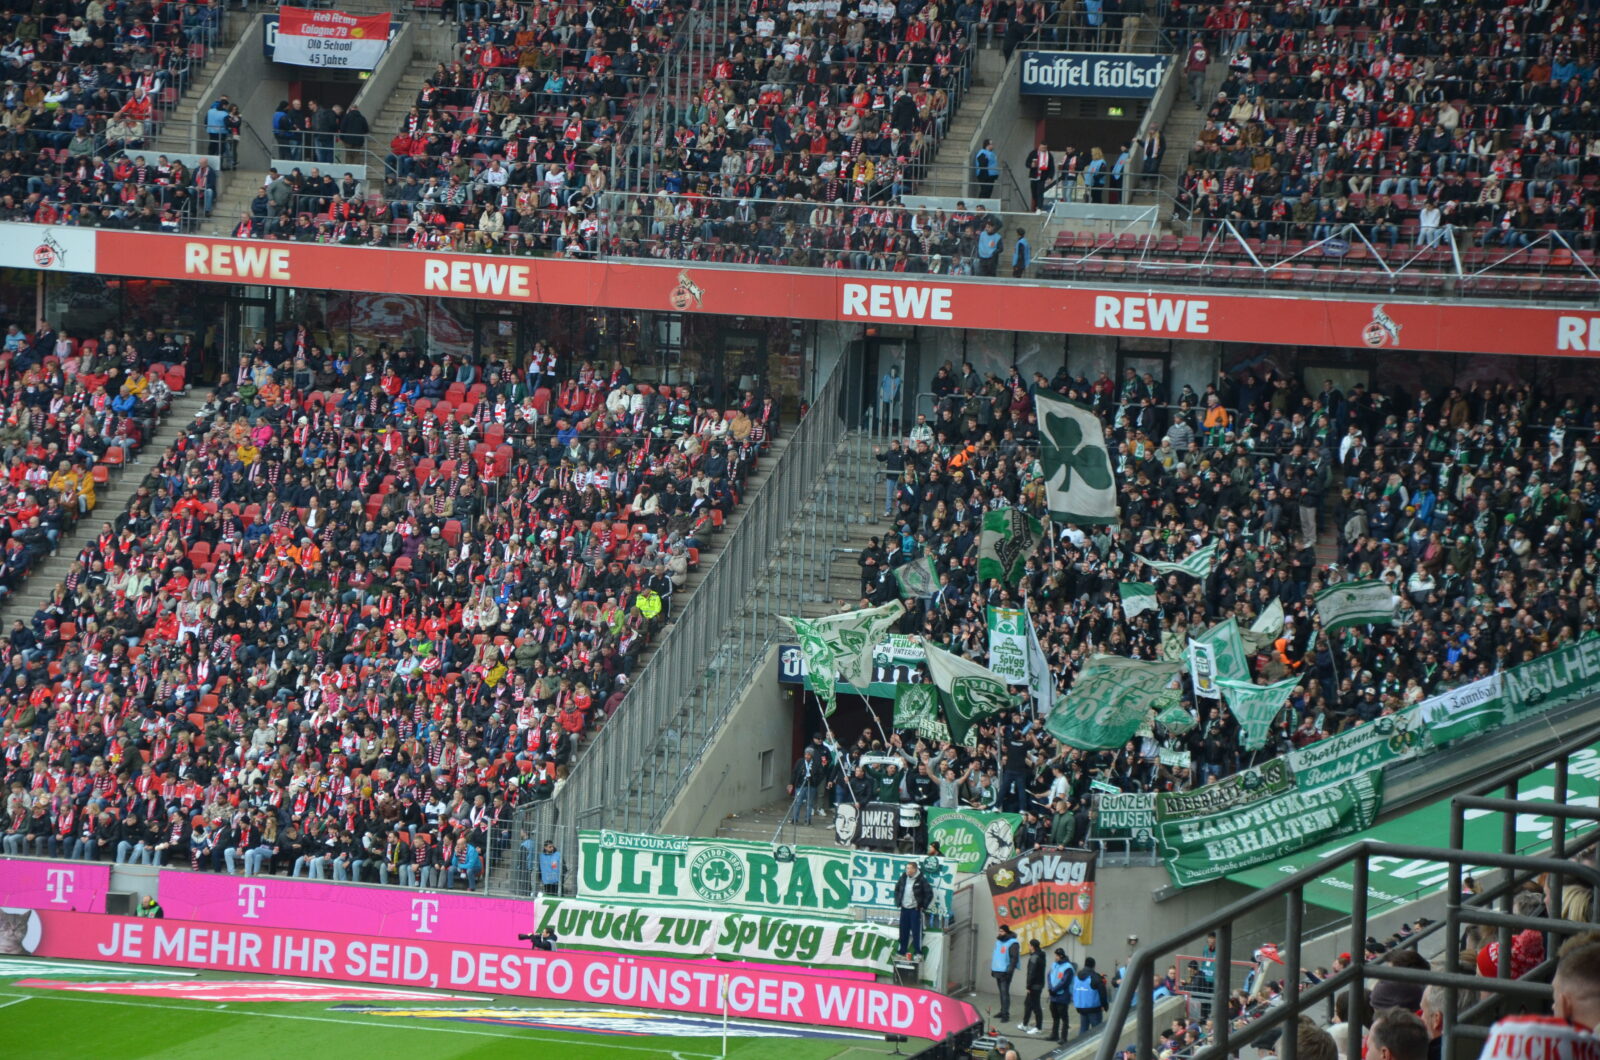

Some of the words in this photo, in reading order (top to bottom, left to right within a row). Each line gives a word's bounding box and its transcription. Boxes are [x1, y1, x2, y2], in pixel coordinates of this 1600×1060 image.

[301, 24, 335, 37] Cologne
[307, 39, 322, 49] Old
[323, 40, 353, 51] School
[322, 54, 348, 66] Jahre
[1023, 57, 1091, 88] Gaffel
[185, 242, 291, 280] REWE
[424, 259, 530, 297] REWE
[843, 283, 953, 320] REWE
[1094, 295, 1209, 334] REWE
[1300, 727, 1378, 767] Sportfreund
[861, 810, 895, 826] IMMER
[1100, 811, 1152, 828] HAUSEN
[1179, 784, 1344, 843] HARDTICKETS
[618, 836, 688, 851] ENTOURAGE
[876, 827, 894, 841] UNS
[933, 828, 973, 847] Bella
[1204, 806, 1340, 861] ERHALTEN!
[45, 868, 75, 903] T
[1017, 855, 1088, 886] SpVgg
[238, 884, 266, 918] T
[698, 886, 736, 901] ULTRAS
[411, 898, 439, 934] T
[536, 899, 650, 943] Zurück
[655, 915, 713, 946] zur
[718, 913, 824, 961] SpVgg
[97, 922, 144, 958] JE
[153, 926, 262, 967] MEHR
[272, 935, 336, 973] IHR
[345, 941, 439, 988] SEID,
[450, 950, 573, 994] DESTO
[583, 957, 805, 1017] GÜNSTIGER
